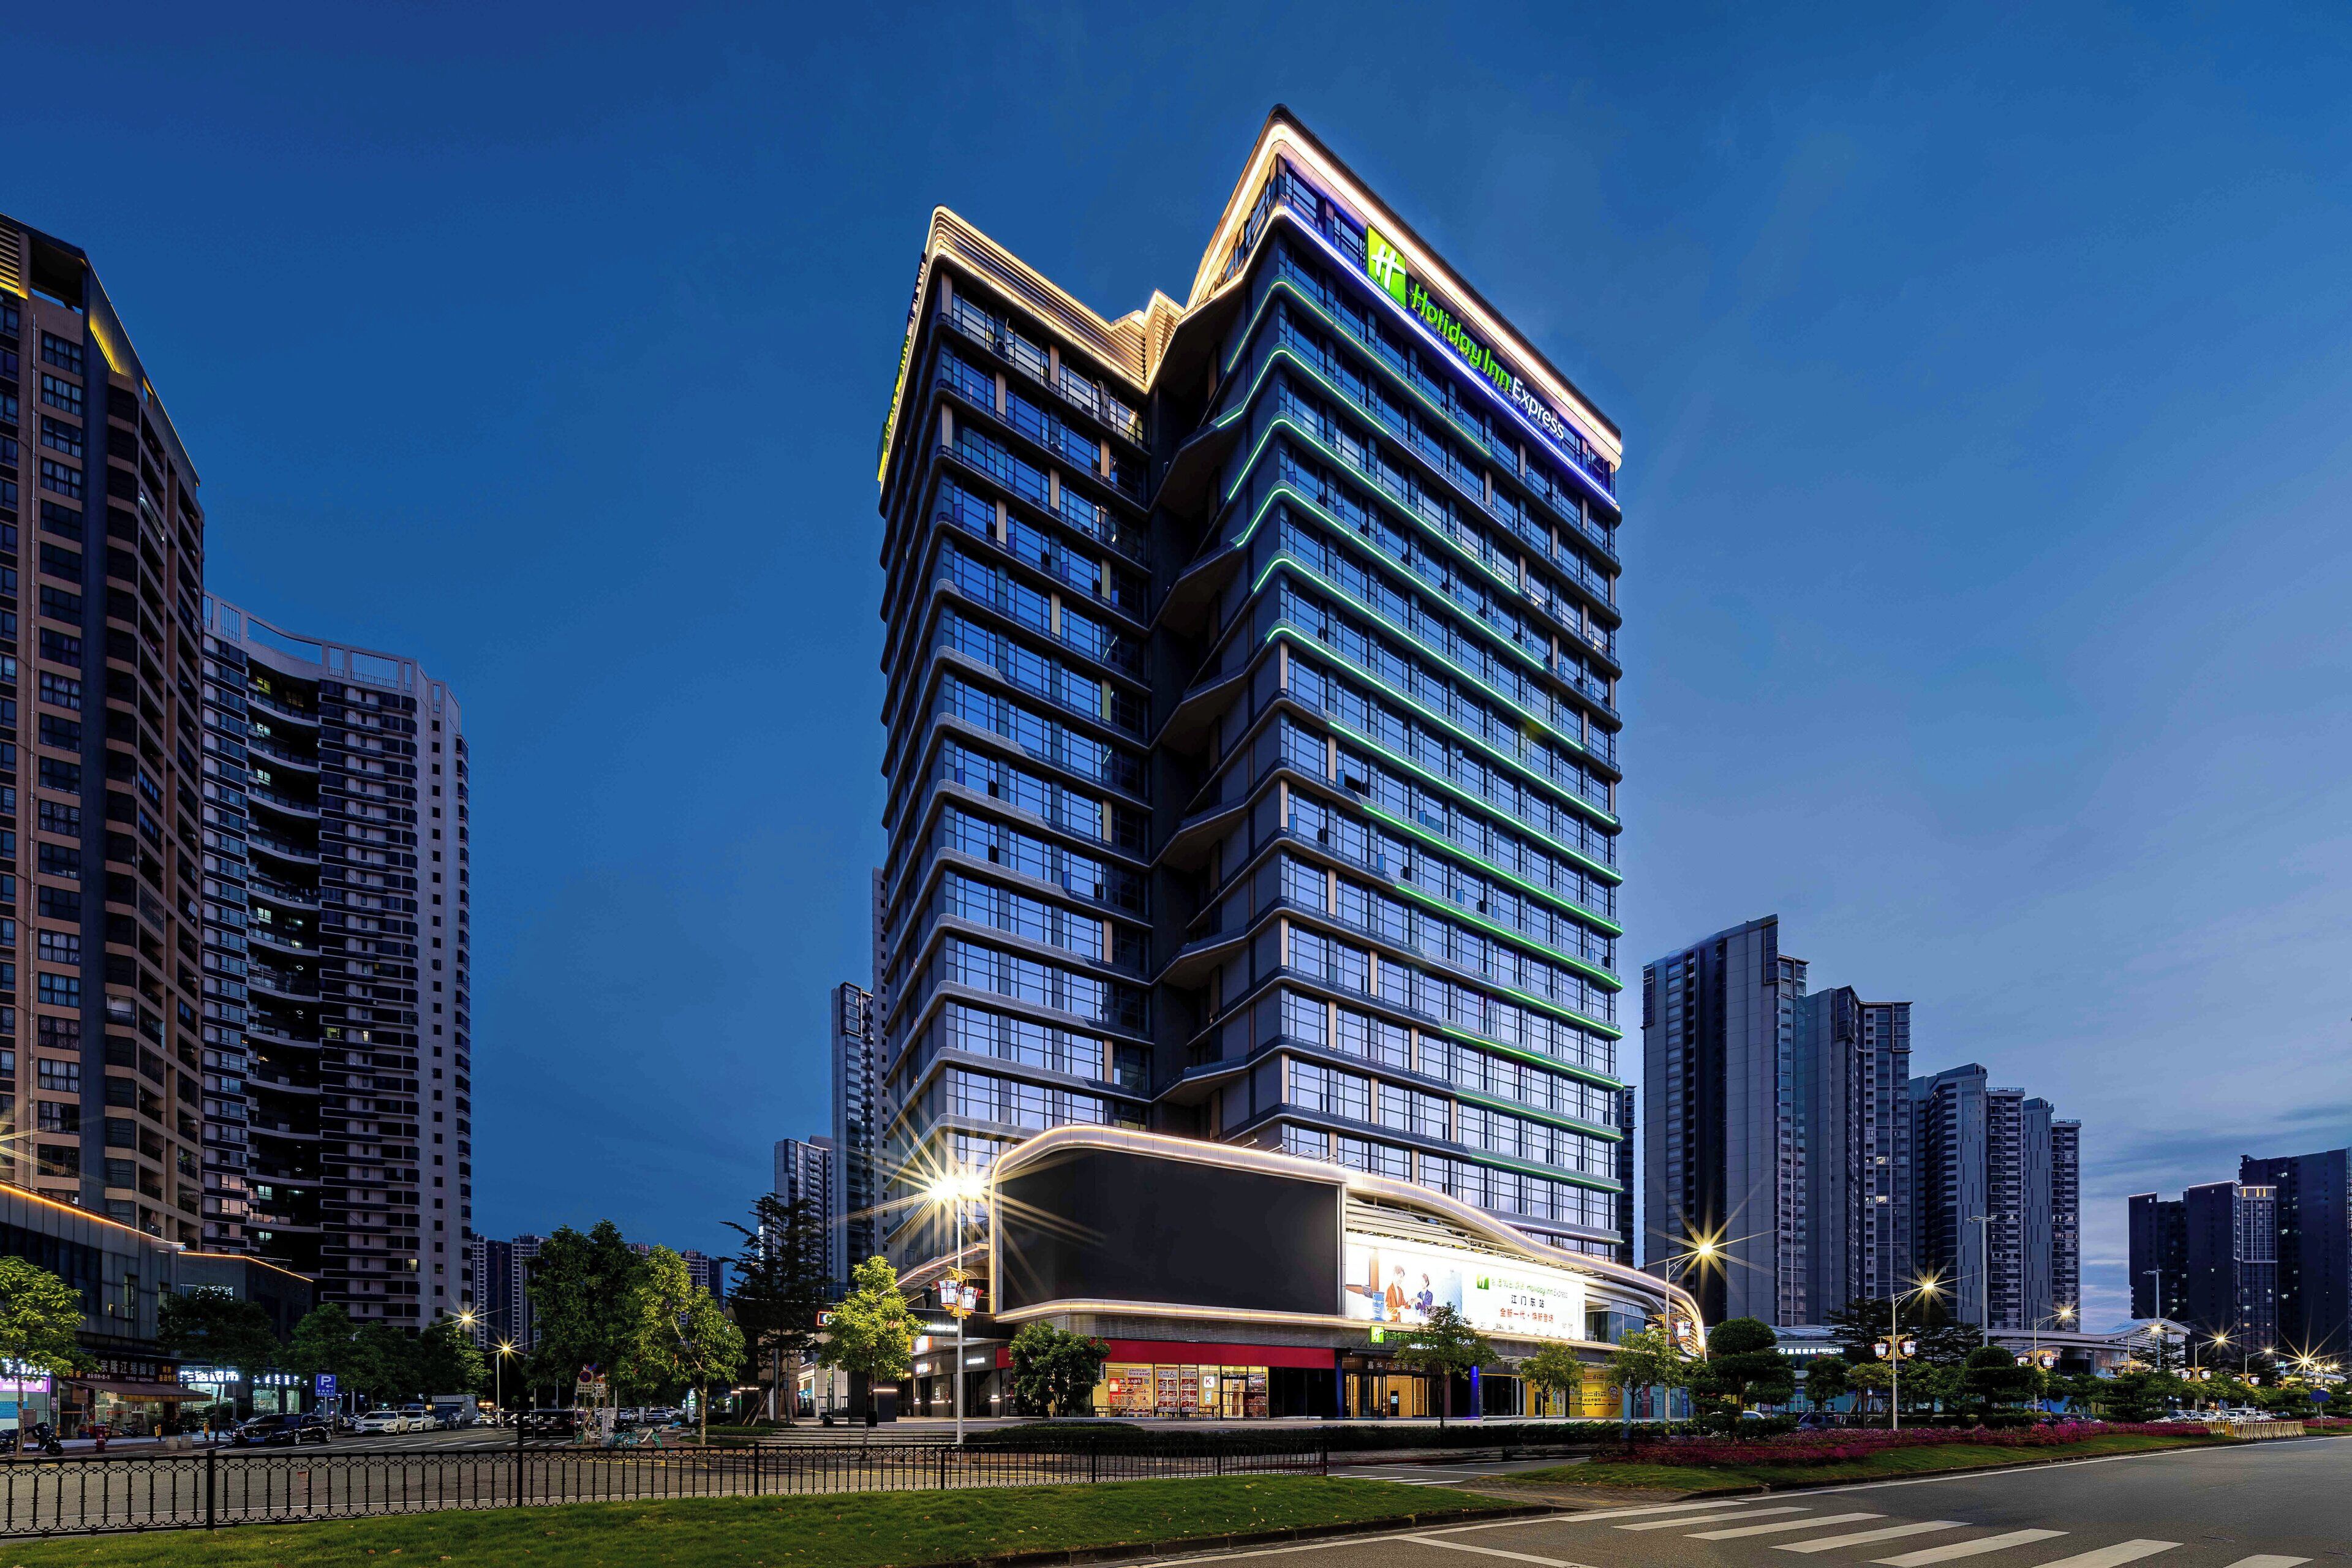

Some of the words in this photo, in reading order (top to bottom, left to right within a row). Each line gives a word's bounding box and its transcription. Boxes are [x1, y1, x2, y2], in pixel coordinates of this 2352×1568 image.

[1410, 283, 1482, 369] Holiday
[1482, 348, 1510, 392] Inn
[1512, 377, 1564, 442] Express
[1511, 1294, 1545, 1308] 江门东站
[321, 1376, 331, 1385] P
